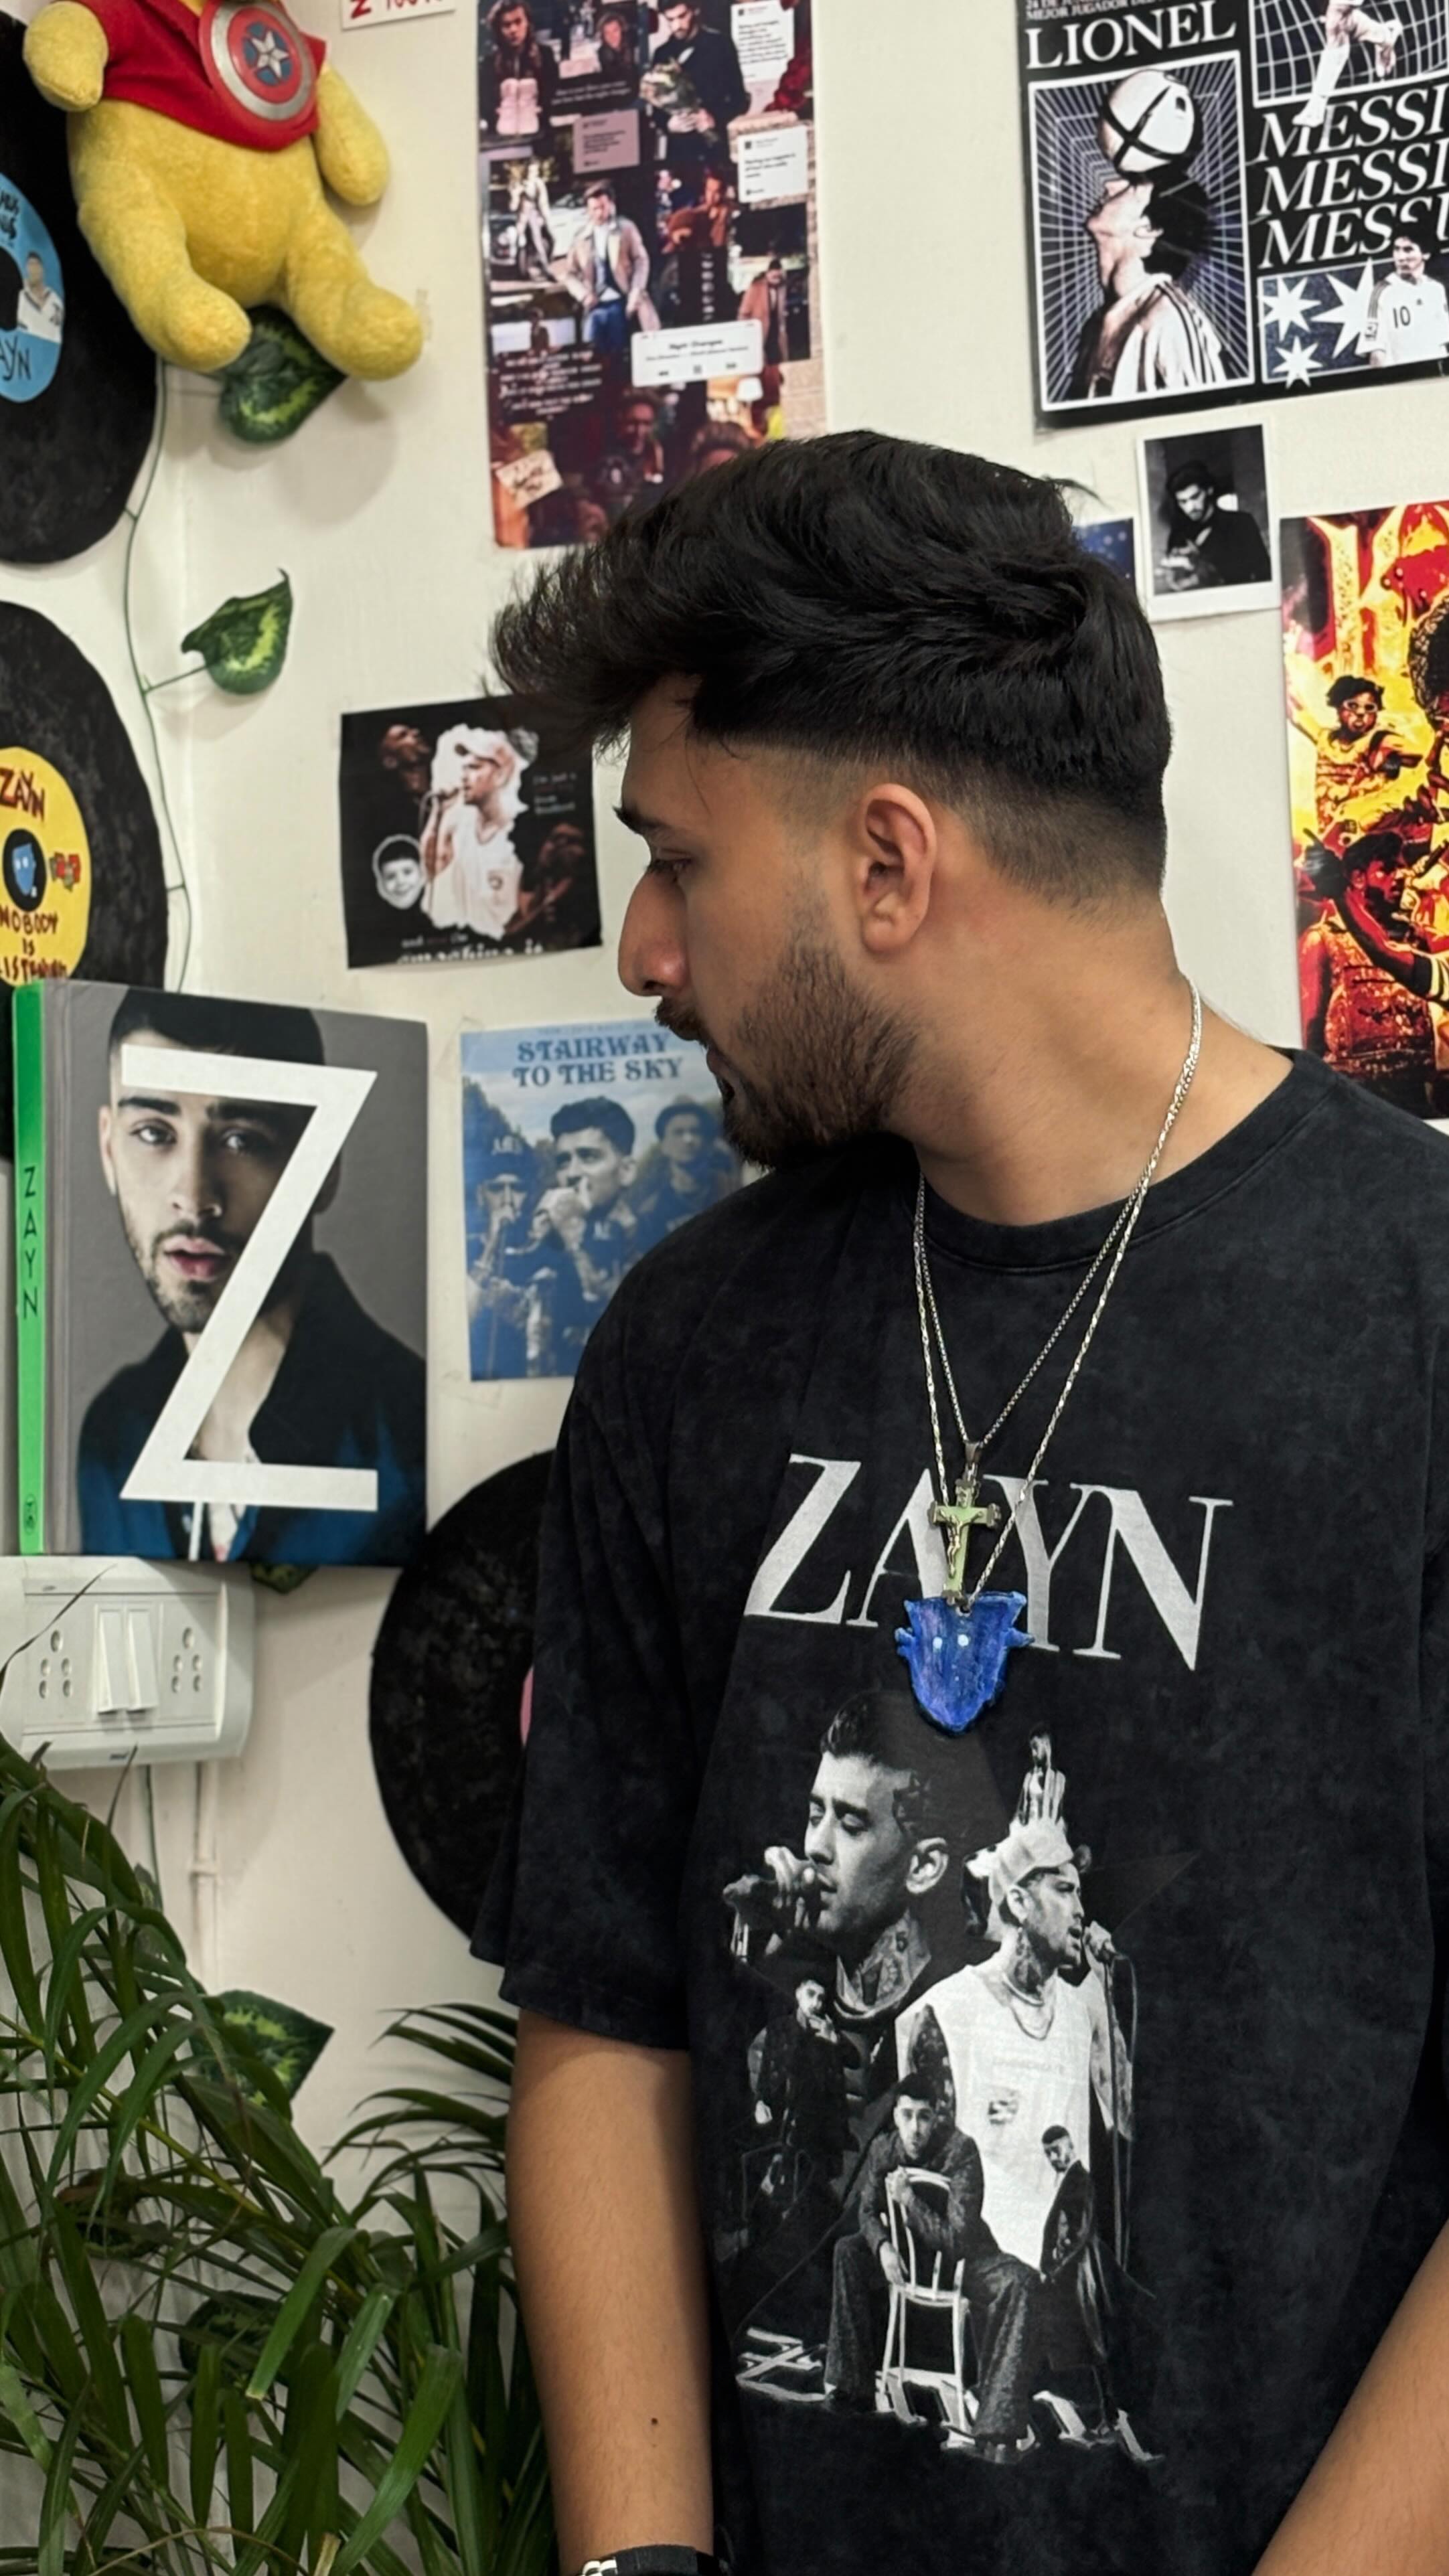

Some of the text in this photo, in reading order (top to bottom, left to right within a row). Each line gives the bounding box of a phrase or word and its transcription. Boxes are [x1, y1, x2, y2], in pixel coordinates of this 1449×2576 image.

[1025, 0, 1237, 69] LIONEL
[1245, 82, 1449, 166] MESSI
[1249, 137, 1449, 226] MESSI
[1393, 305, 1411, 329] 10
[0, 335, 31, 382] AYN
[0, 768, 46, 823] ZAYN
[0, 904, 58, 935] NOBODY
[22, 938, 35, 956] IS
[512, 1056, 684, 1088] TO THE SKY
[518, 1032, 670, 1063] STAIRWAY
[23, 1165, 38, 1320] ZAYN
[121, 1044, 377, 1512] Z
[743, 1452, 1234, 1672] ZAYN
